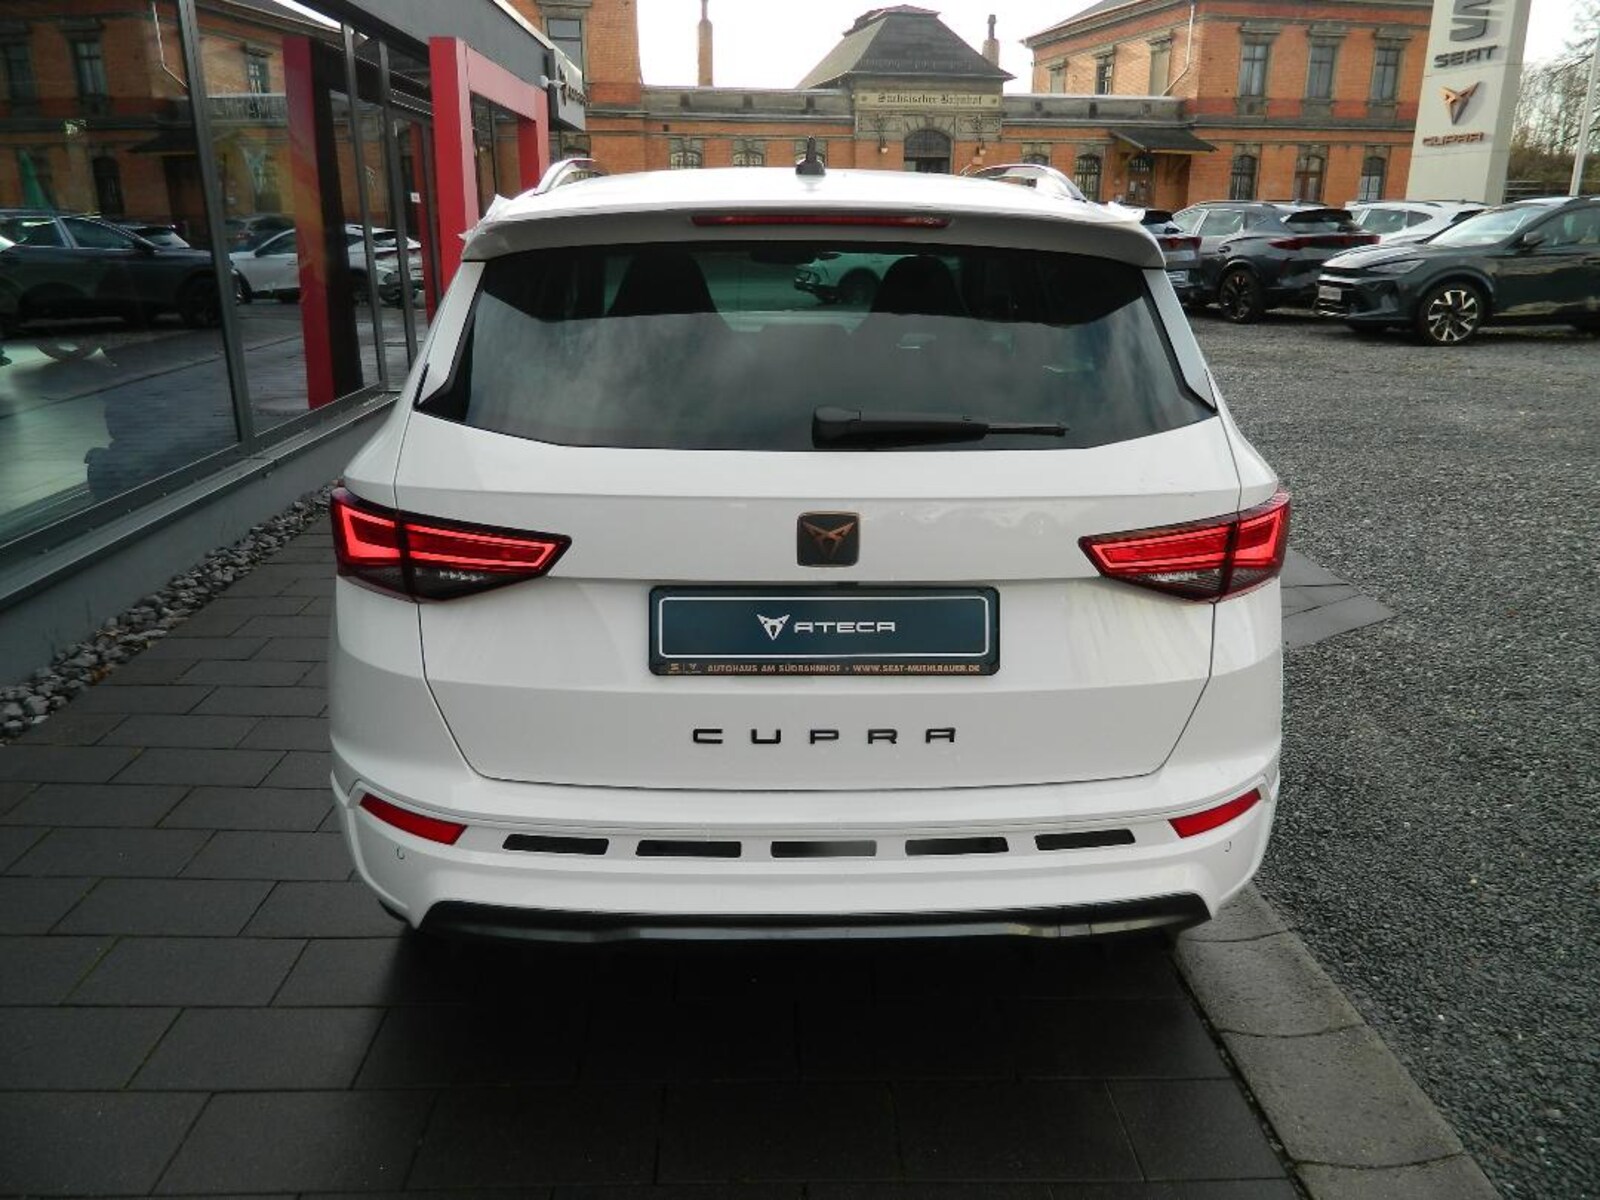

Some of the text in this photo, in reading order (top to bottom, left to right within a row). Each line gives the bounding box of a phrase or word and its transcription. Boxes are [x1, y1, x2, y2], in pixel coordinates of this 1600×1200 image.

[1434, 45, 1498, 68] SEAT
[1422, 132, 1484, 147] CUPRA
[794, 621, 896, 634] ATECA
[707, 664, 758, 673] AUTOHAUS
[761, 664, 776, 673] AM
[692, 728, 956, 745] CUPRA
